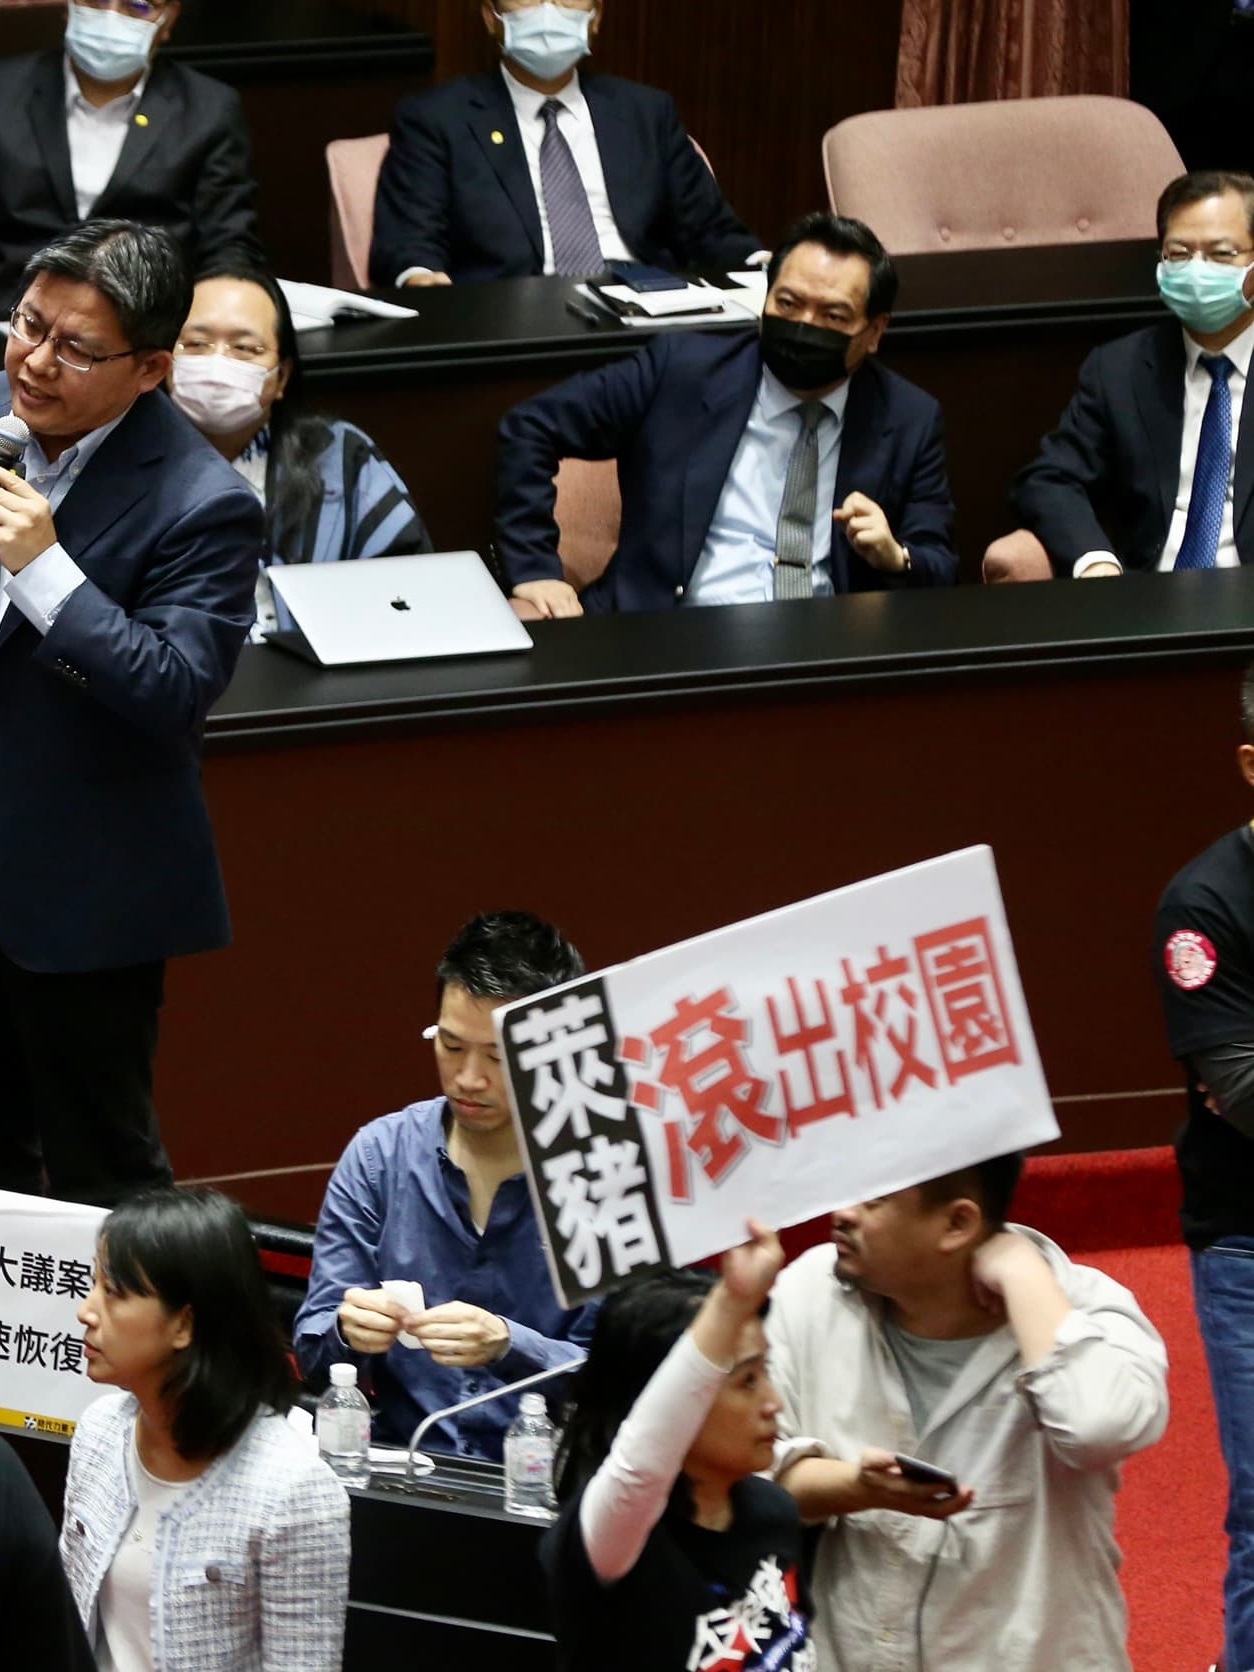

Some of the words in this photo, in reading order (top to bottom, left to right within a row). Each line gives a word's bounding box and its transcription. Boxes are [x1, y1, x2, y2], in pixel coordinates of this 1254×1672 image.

[511, 994, 660, 1288] 萊豬
[616, 916, 1021, 1203] 滾出校園
